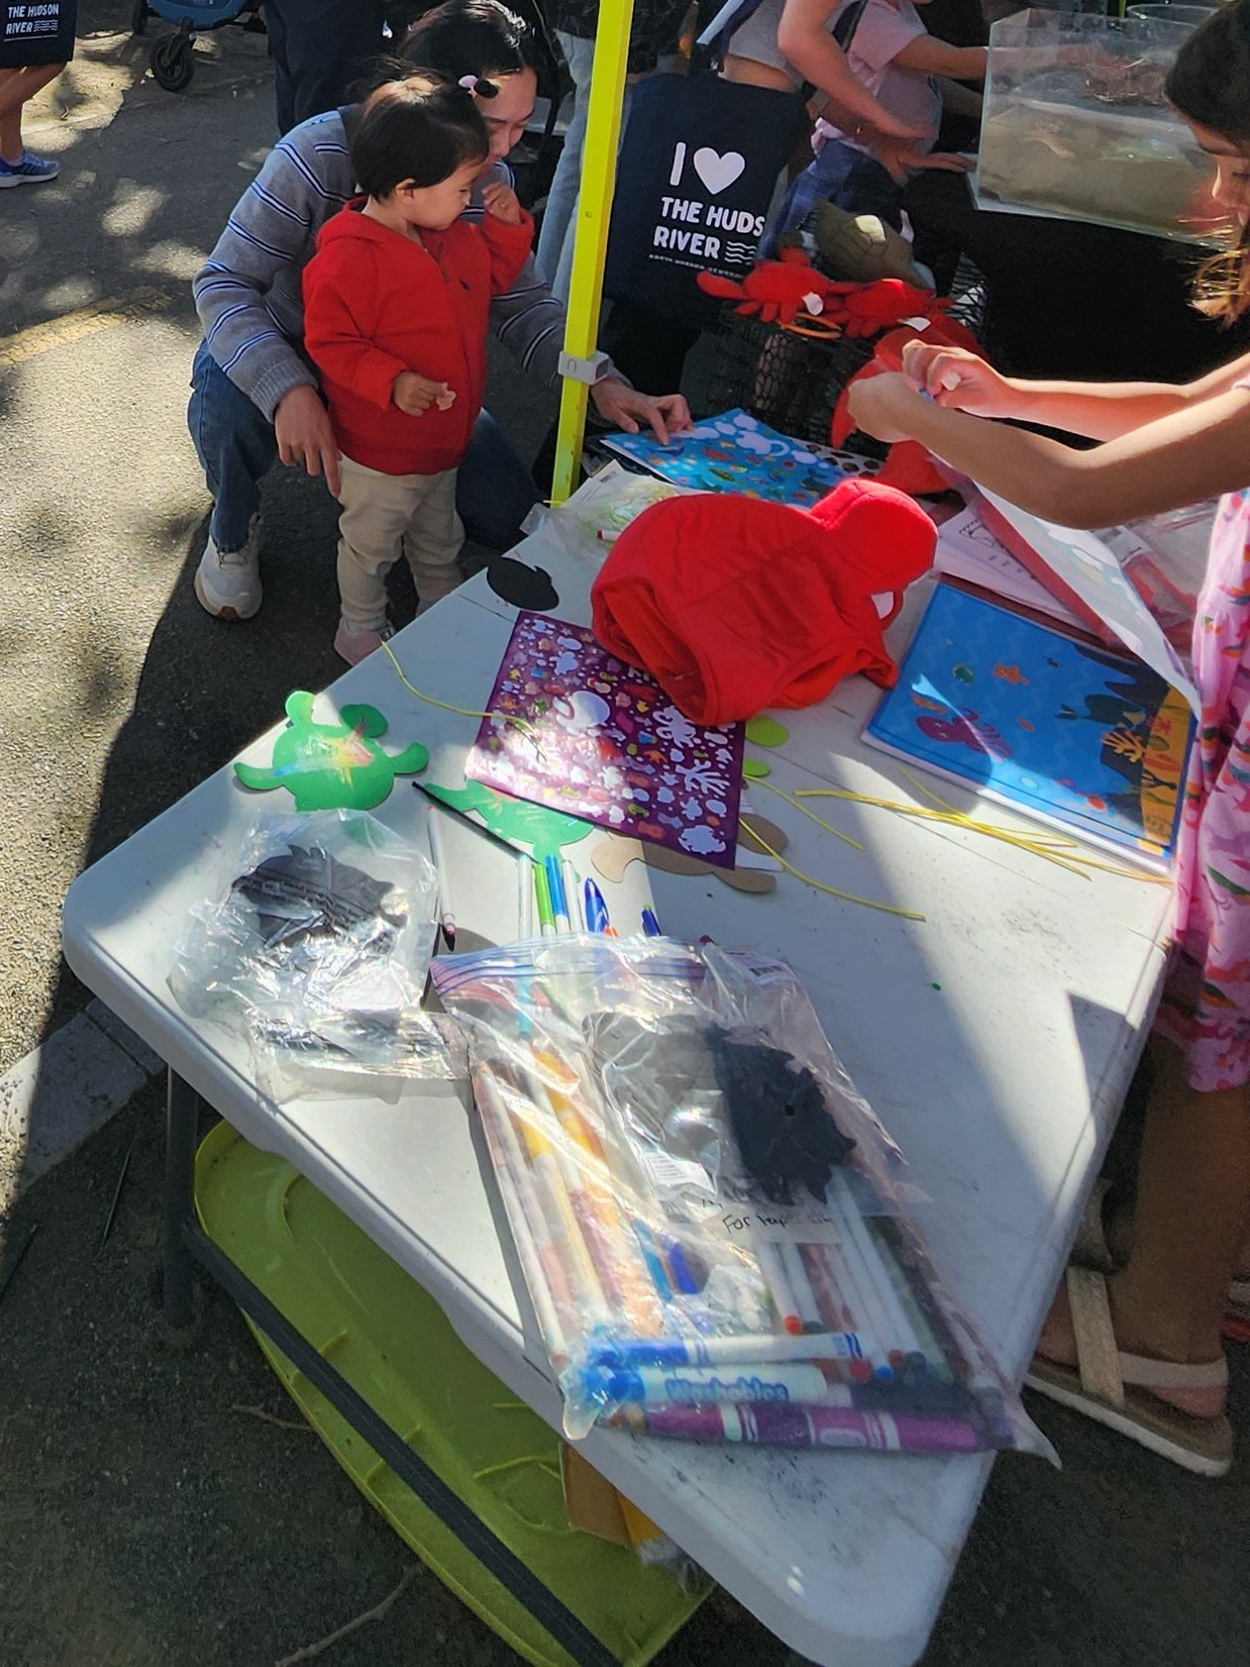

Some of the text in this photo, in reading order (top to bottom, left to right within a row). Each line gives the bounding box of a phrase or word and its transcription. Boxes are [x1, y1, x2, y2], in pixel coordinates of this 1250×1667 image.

[7, 3, 59, 19] THE HUDSON
[5, 21, 33, 35] RIVER
[661, 196, 704, 224] THE
[652, 225, 721, 260] RIVER
